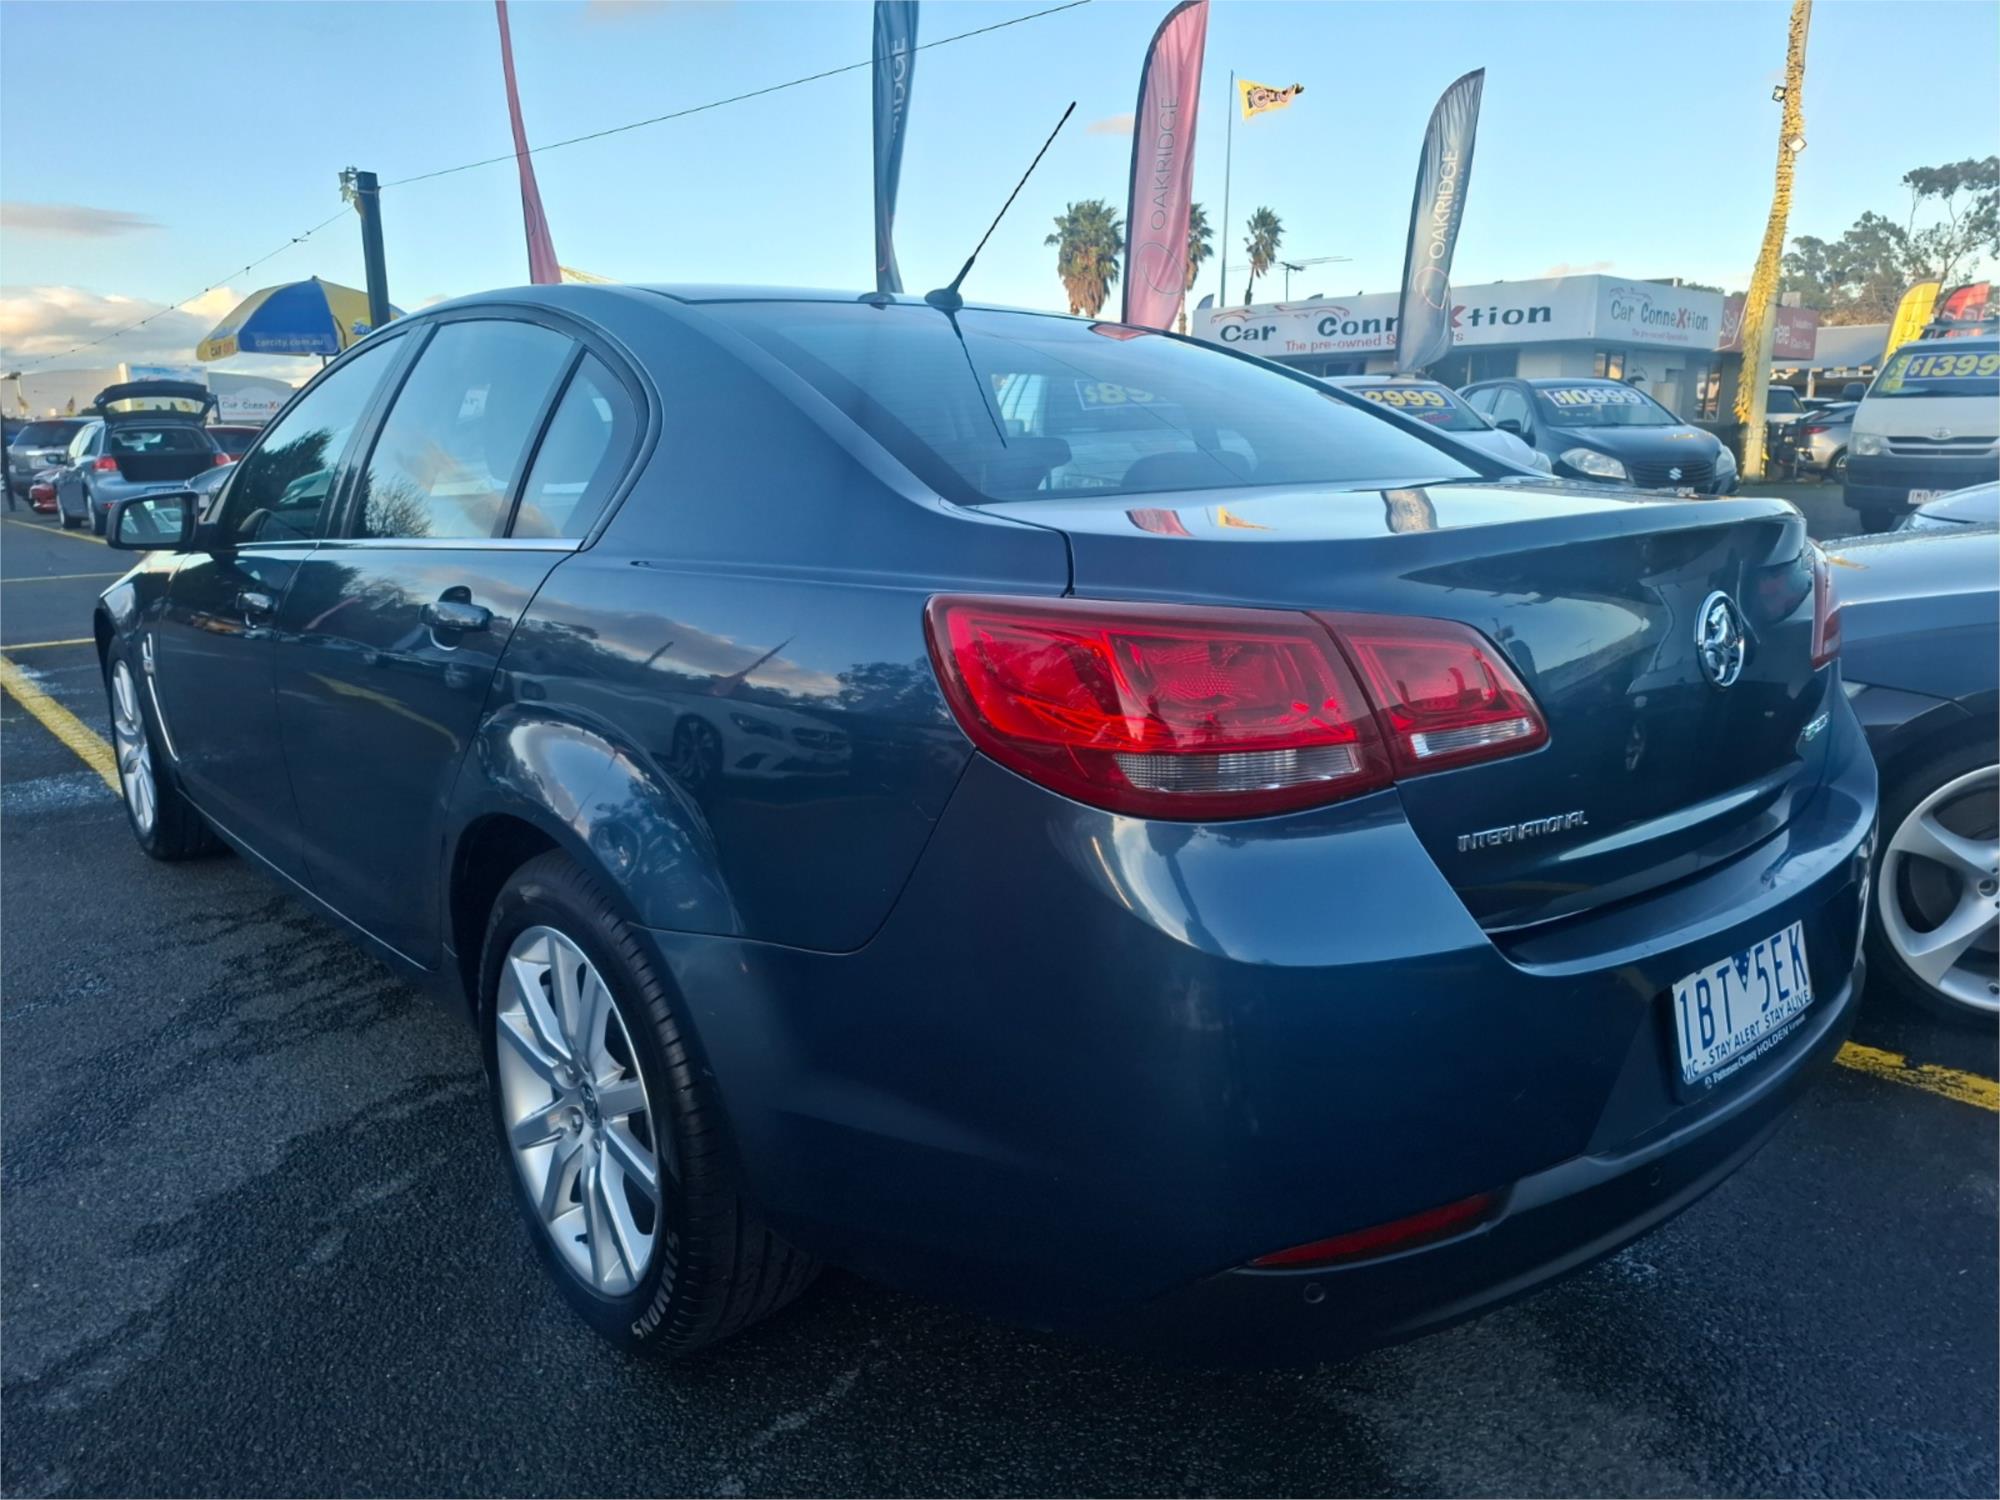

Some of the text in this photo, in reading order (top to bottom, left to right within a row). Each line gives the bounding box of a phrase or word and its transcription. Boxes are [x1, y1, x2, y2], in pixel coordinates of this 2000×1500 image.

[1151, 96, 1179, 231] OAKRIDGE
[1428, 150, 1458, 260] OAKRIDGE
[1220, 324, 1276, 342] Car
[1611, 300, 1635, 321] Car
[1641, 302, 1709, 331] ConneXtion
[1286, 340, 1306, 352] The
[1311, 335, 1381, 353] pre-owned
[1457, 810, 1589, 853] INTERNATIONAL
[1683, 1059, 1699, 1081] VIC
[1709, 1041, 1732, 1066] STAY
[1734, 1020, 1761, 1051] ALERT
[1764, 1006, 1786, 1029] STAY
[1787, 989, 1810, 1014] ALIVE
[1757, 1024, 1789, 1056] HOLDEN
